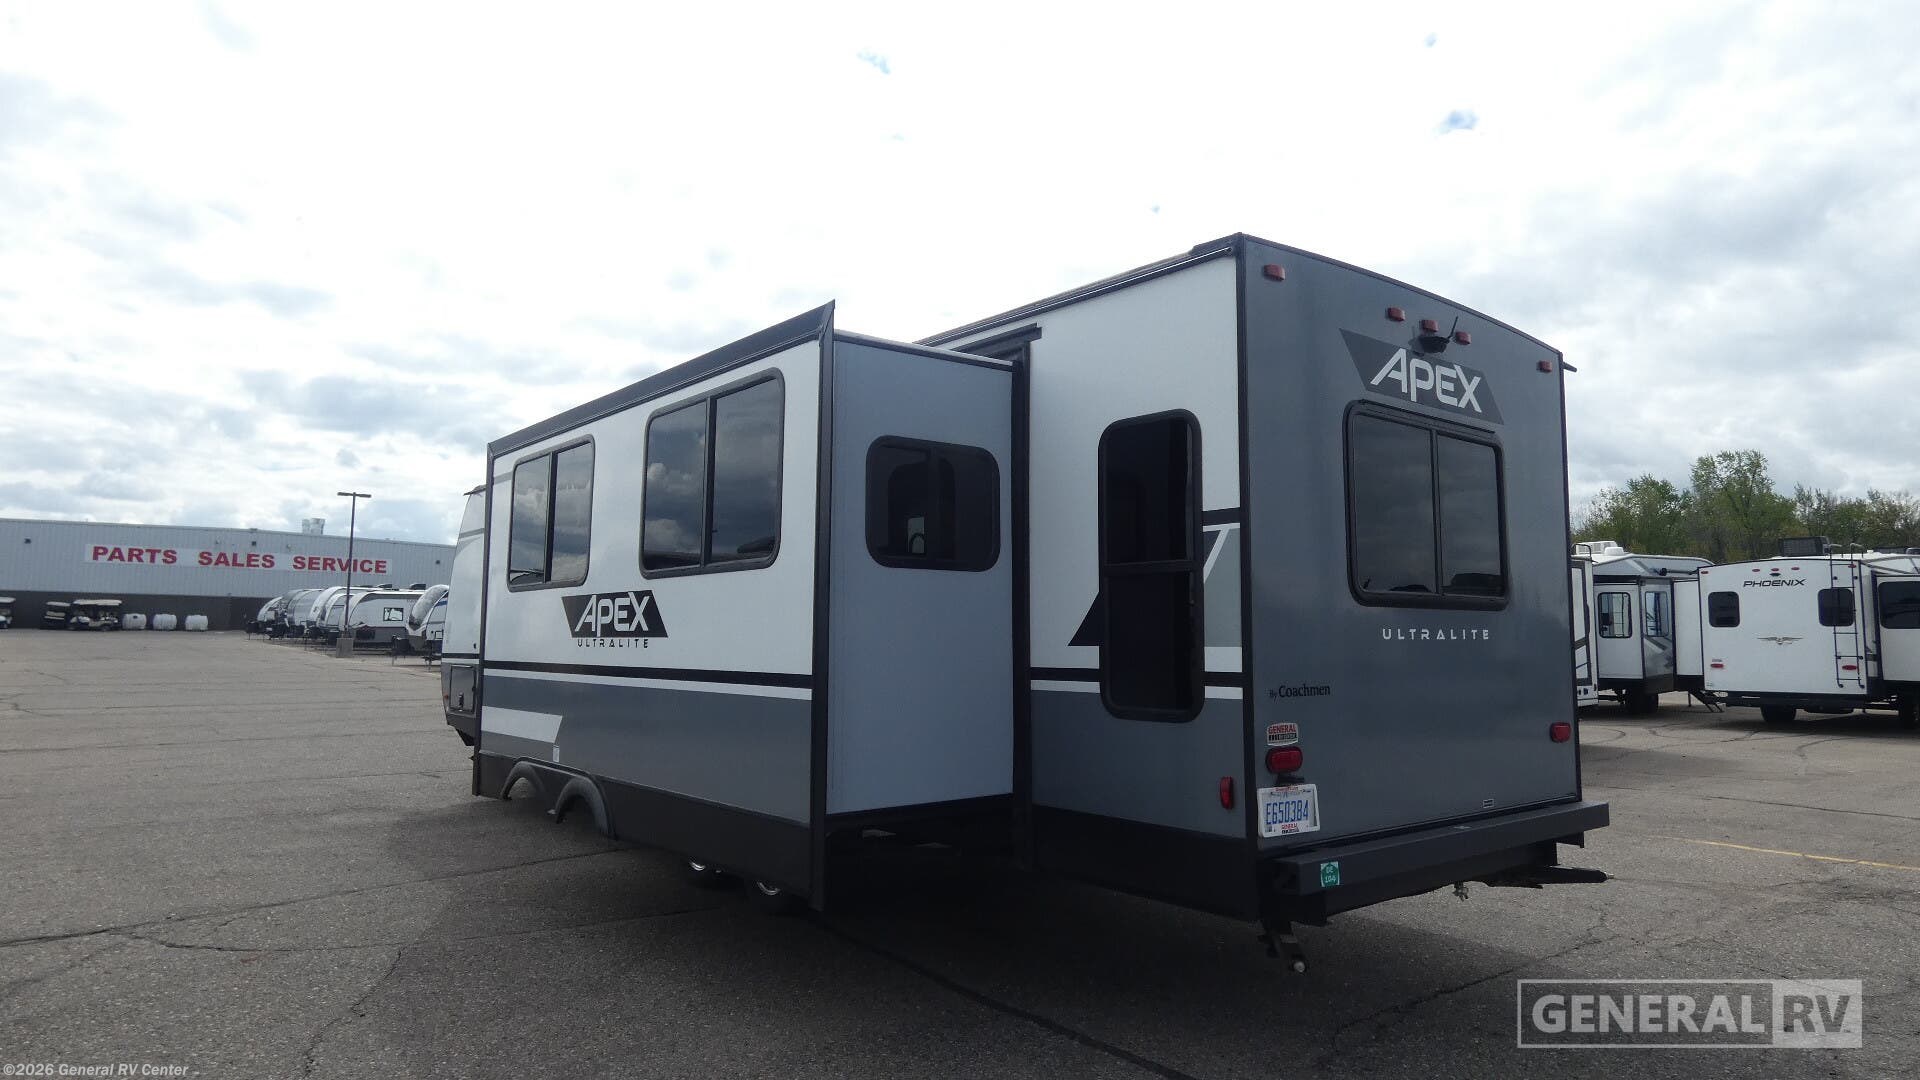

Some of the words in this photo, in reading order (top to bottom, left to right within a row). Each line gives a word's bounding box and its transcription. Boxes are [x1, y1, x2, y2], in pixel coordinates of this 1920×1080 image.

[1370, 347, 1482, 413] APEX
[92, 546, 177, 564] PARTS
[198, 551, 275, 568] SALES
[293, 556, 387, 573] SERVICE
[1743, 579, 1806, 587] PHOENIX
[574, 591, 650, 637] APEX
[577, 638, 649, 649] ULTRALITE
[1382, 628, 1489, 640] ULTRALITE
[1279, 683, 1331, 698] Coachmen
[1266, 799, 1309, 825] E650384
